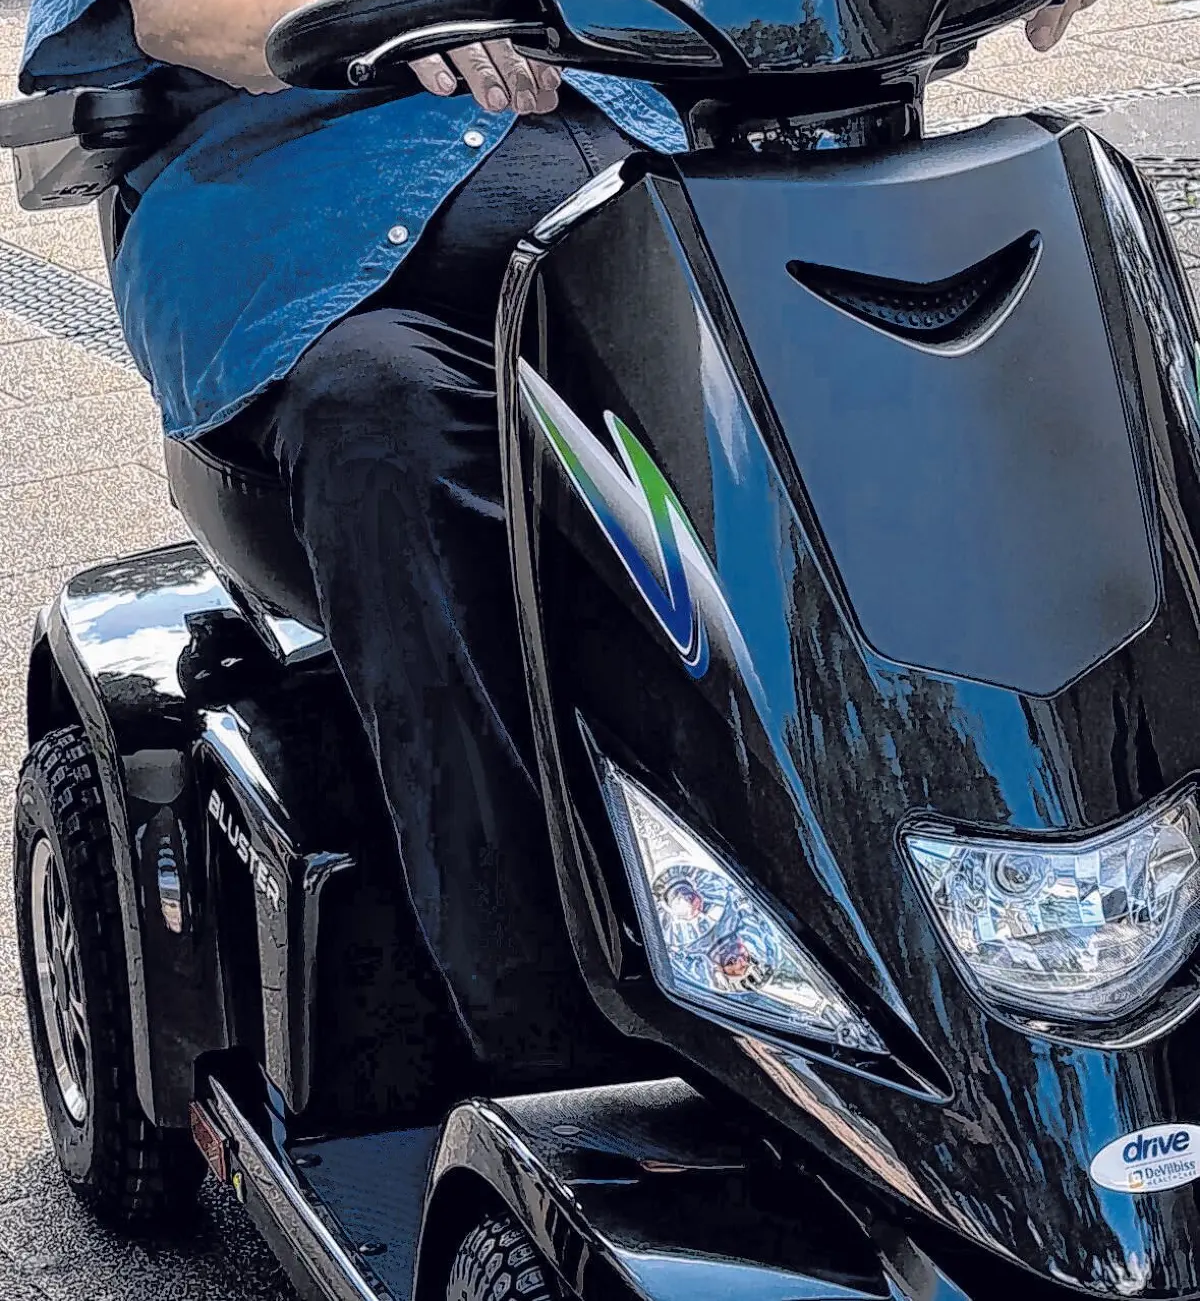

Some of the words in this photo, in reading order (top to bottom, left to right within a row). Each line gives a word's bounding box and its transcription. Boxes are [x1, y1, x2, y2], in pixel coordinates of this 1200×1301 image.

[209, 789, 279, 912] BLUSTER
[1123, 1131, 1190, 1163] drive
[1145, 1161, 1196, 1179] DeVilbiss
